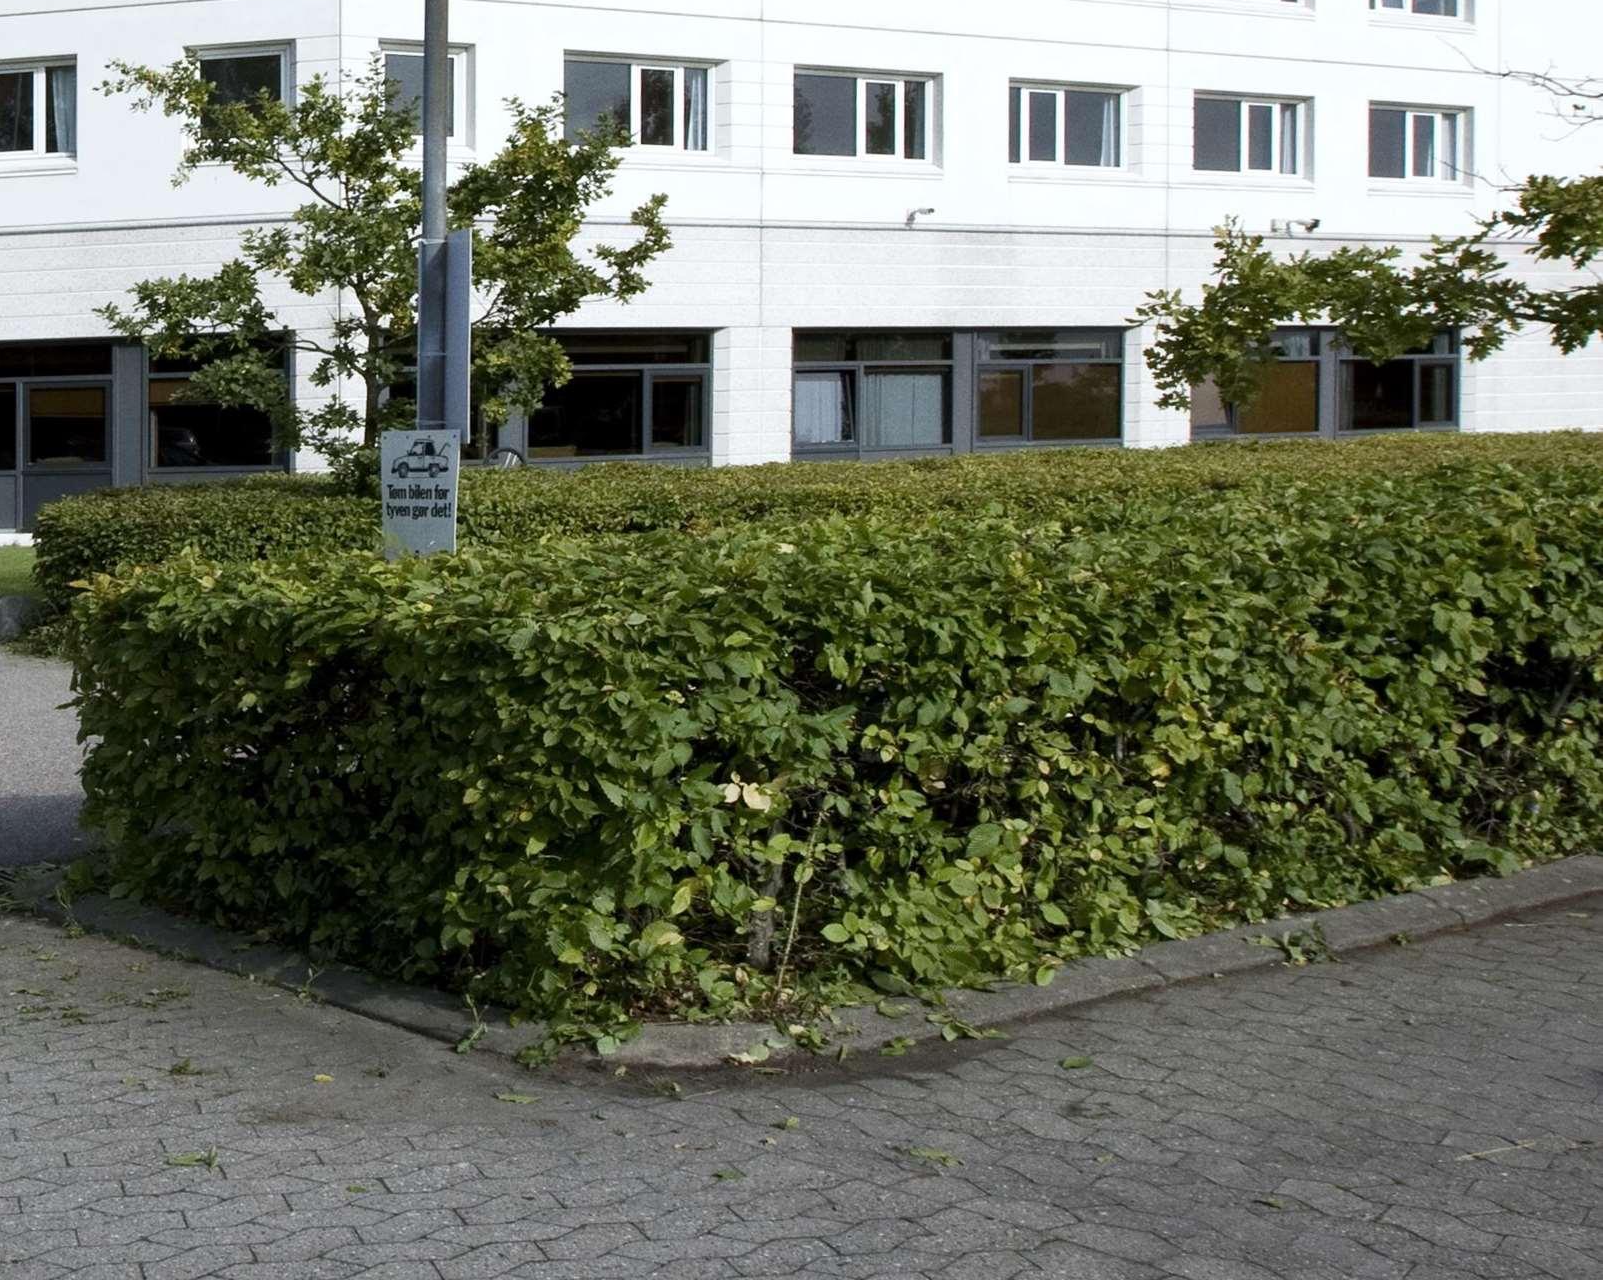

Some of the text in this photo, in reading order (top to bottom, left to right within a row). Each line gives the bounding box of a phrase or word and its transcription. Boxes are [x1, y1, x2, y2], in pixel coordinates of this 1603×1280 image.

[408, 484, 432, 500] bilen
[434, 484, 450, 500] før
[386, 502, 452, 520] tyven gør det!
